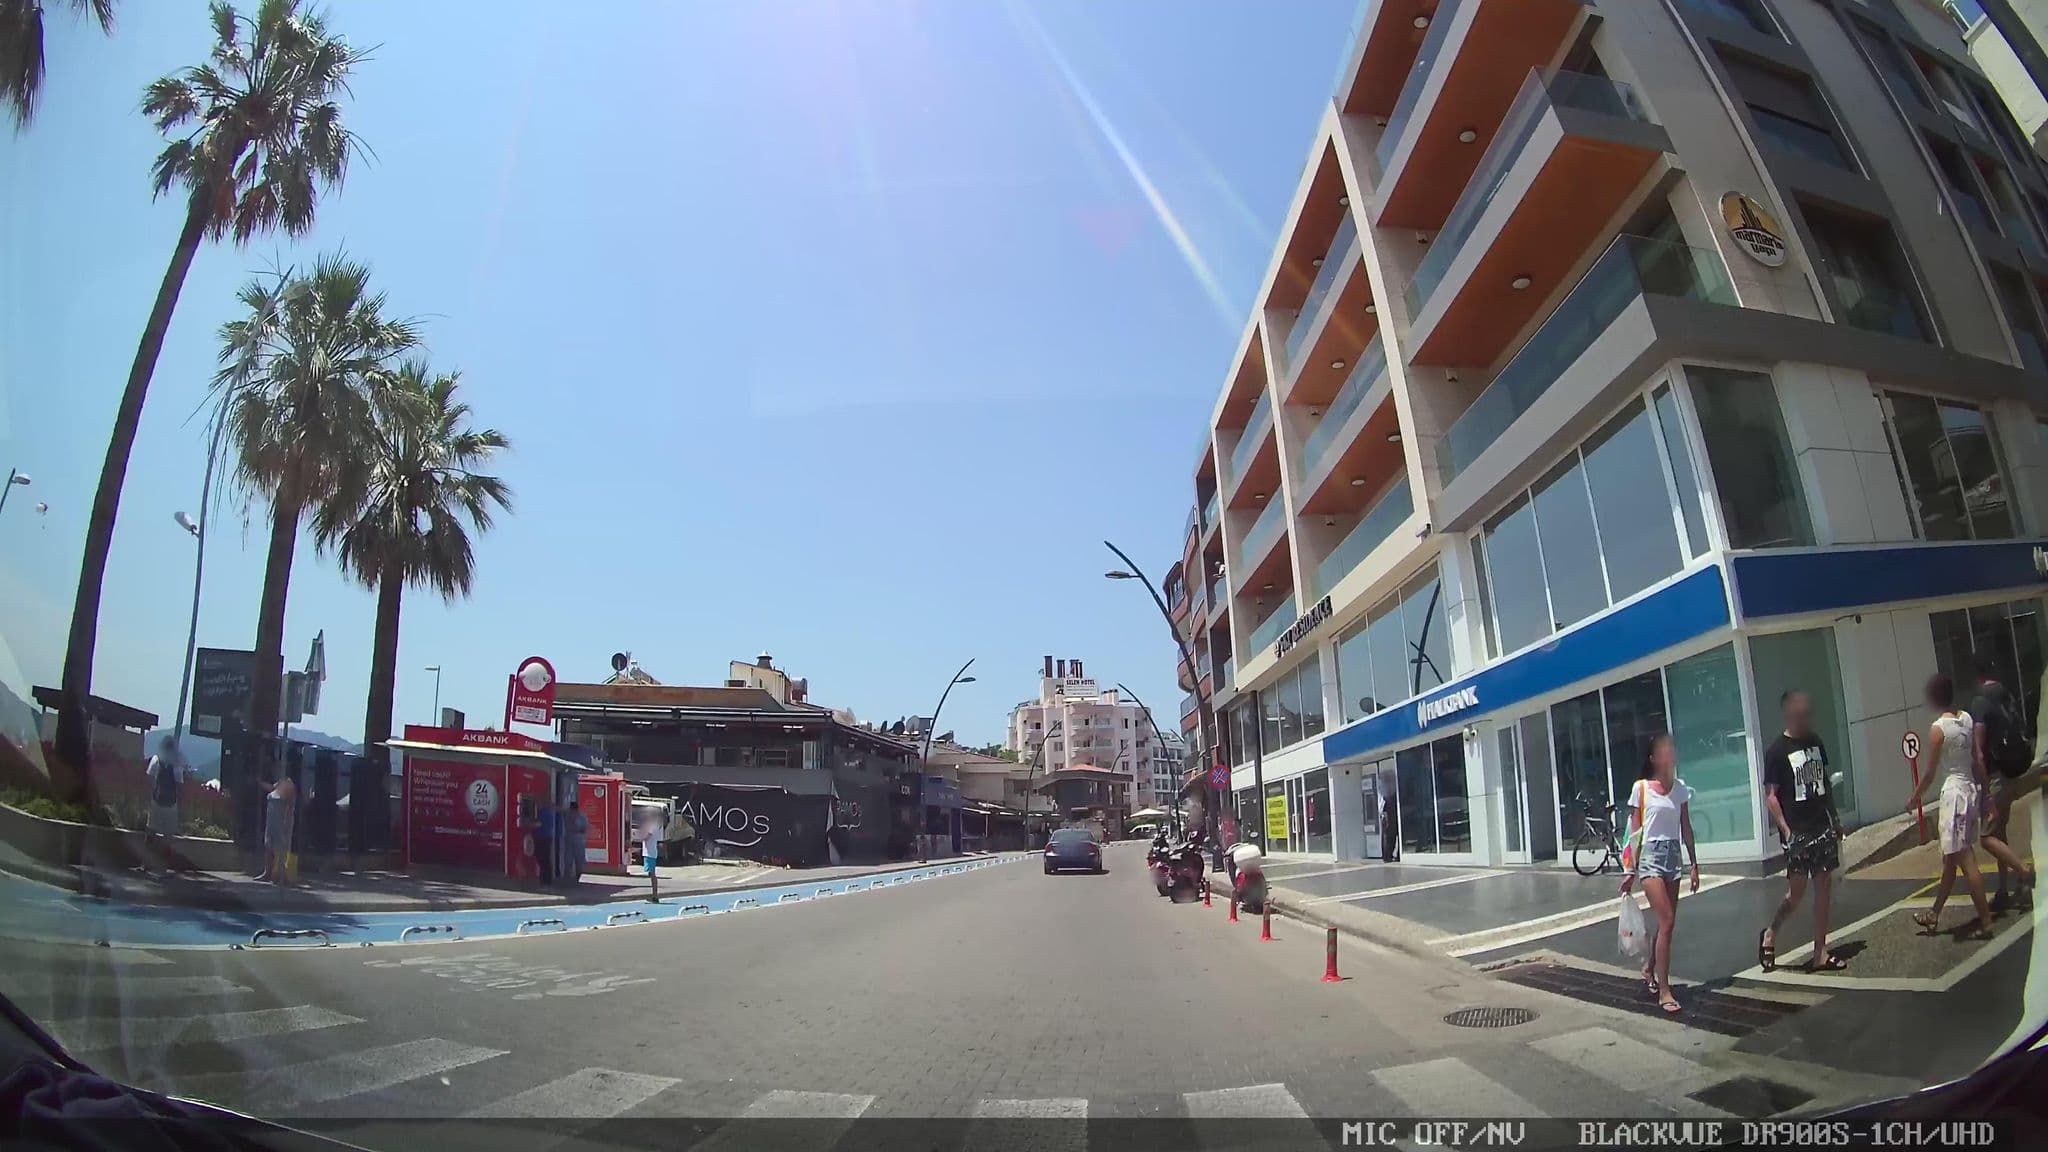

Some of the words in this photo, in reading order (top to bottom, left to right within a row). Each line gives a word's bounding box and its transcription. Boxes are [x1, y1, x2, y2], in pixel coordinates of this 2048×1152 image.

[517, 696, 547, 704] AKBANK
[1426, 685, 1480, 721] HALKBANK
[462, 734, 509, 744] AKBANK
[475, 783, 488, 794] 24
[681, 801, 770, 834] AMOS
